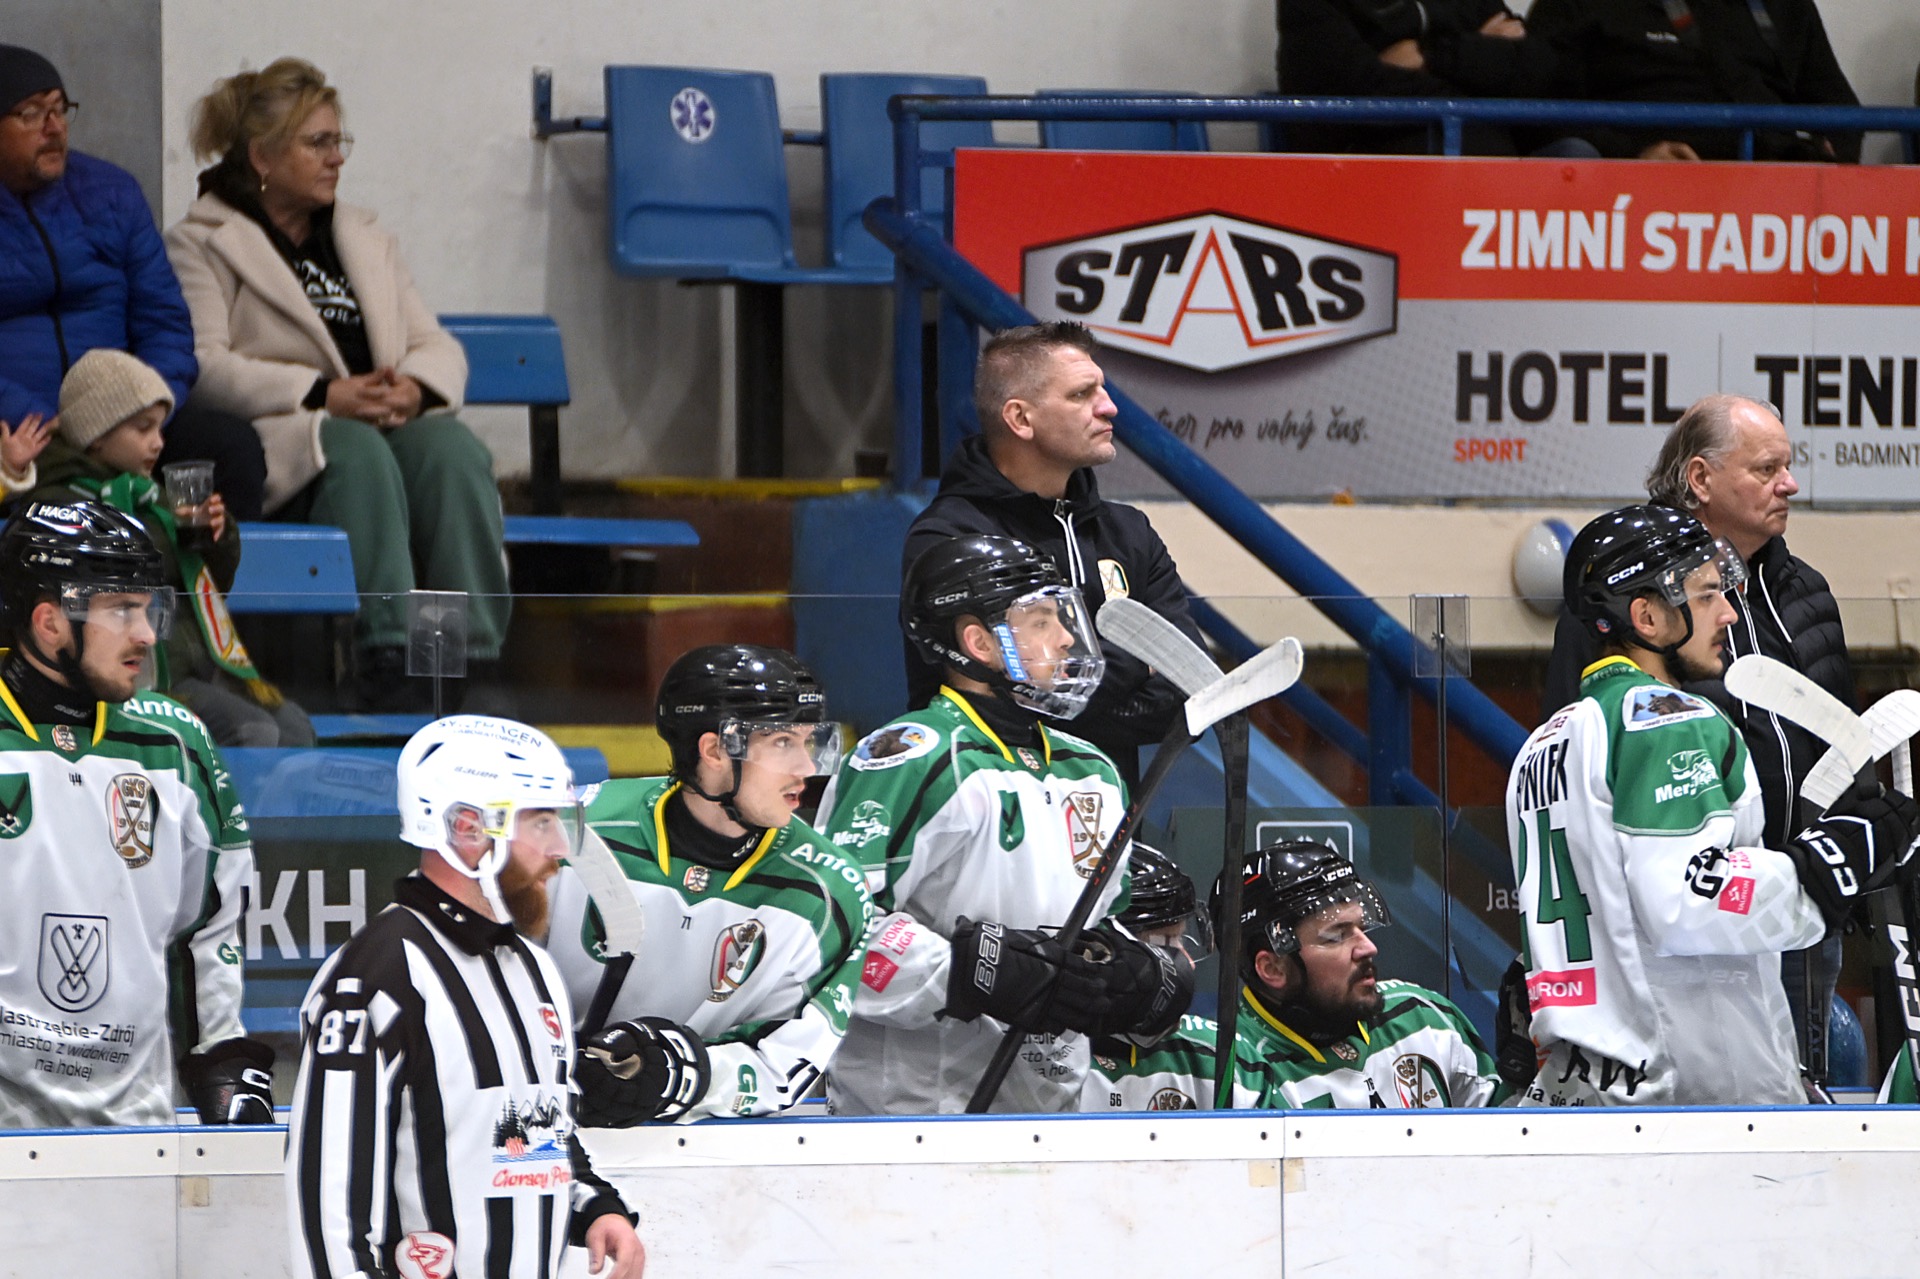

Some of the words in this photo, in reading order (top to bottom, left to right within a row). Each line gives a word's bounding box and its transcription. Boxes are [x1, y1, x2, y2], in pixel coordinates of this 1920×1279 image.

[1461, 194, 1632, 270] ZIMNÍ
[1640, 213, 1889, 275] STADION
[1055, 227, 1366, 347] STARS
[1456, 351, 1690, 425] HOTEL
[1207, 416, 1244, 449] pro
[1257, 409, 1316, 450] volný
[1454, 439, 1527, 463] SPORT
[1607, 561, 1645, 586] CCM
[933, 591, 969, 606] CCM
[996, 624, 1025, 681] BAUER
[675, 705, 705, 714] CCM
[798, 693, 823, 703] CCM
[1044, 791, 1052, 805] 3
[1327, 866, 1354, 882] CCM
[1737, 879, 1750, 912] TAURON
[892, 930, 917, 956] LIGA
[871, 961, 892, 988] TAURON
[316, 1009, 369, 1055] 87
[0, 1030, 52, 1052] miasto
[56, 1042, 65, 1055] z
[67, 1044, 130, 1065] widokiem
[34, 1058, 53, 1073] na
[56, 1059, 93, 1083] hokej
[1109, 1092, 1122, 1107] 56
